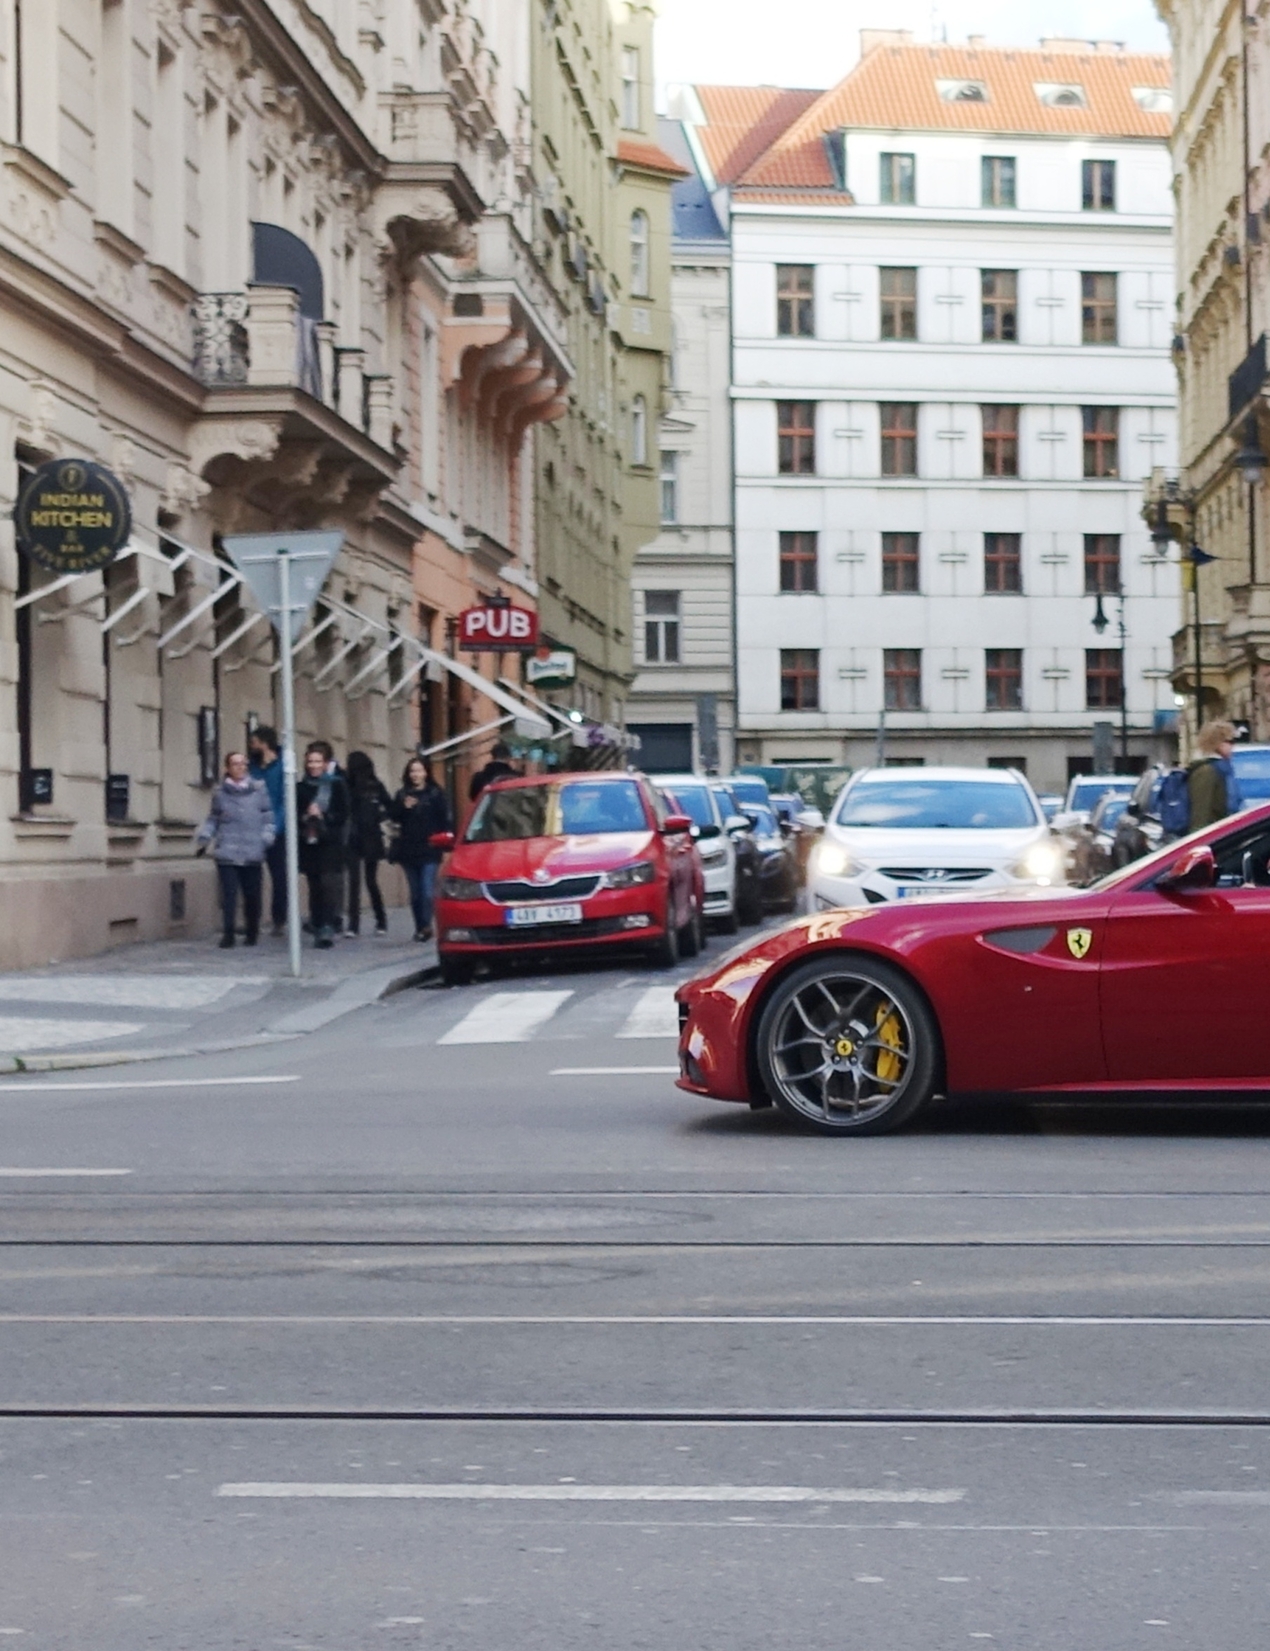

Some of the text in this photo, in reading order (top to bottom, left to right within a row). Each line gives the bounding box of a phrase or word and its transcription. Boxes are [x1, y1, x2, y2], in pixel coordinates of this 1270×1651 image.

[40, 494, 104, 507] INDIAN
[31, 511, 112, 528] KITCHEN
[466, 609, 531, 638] PUB
